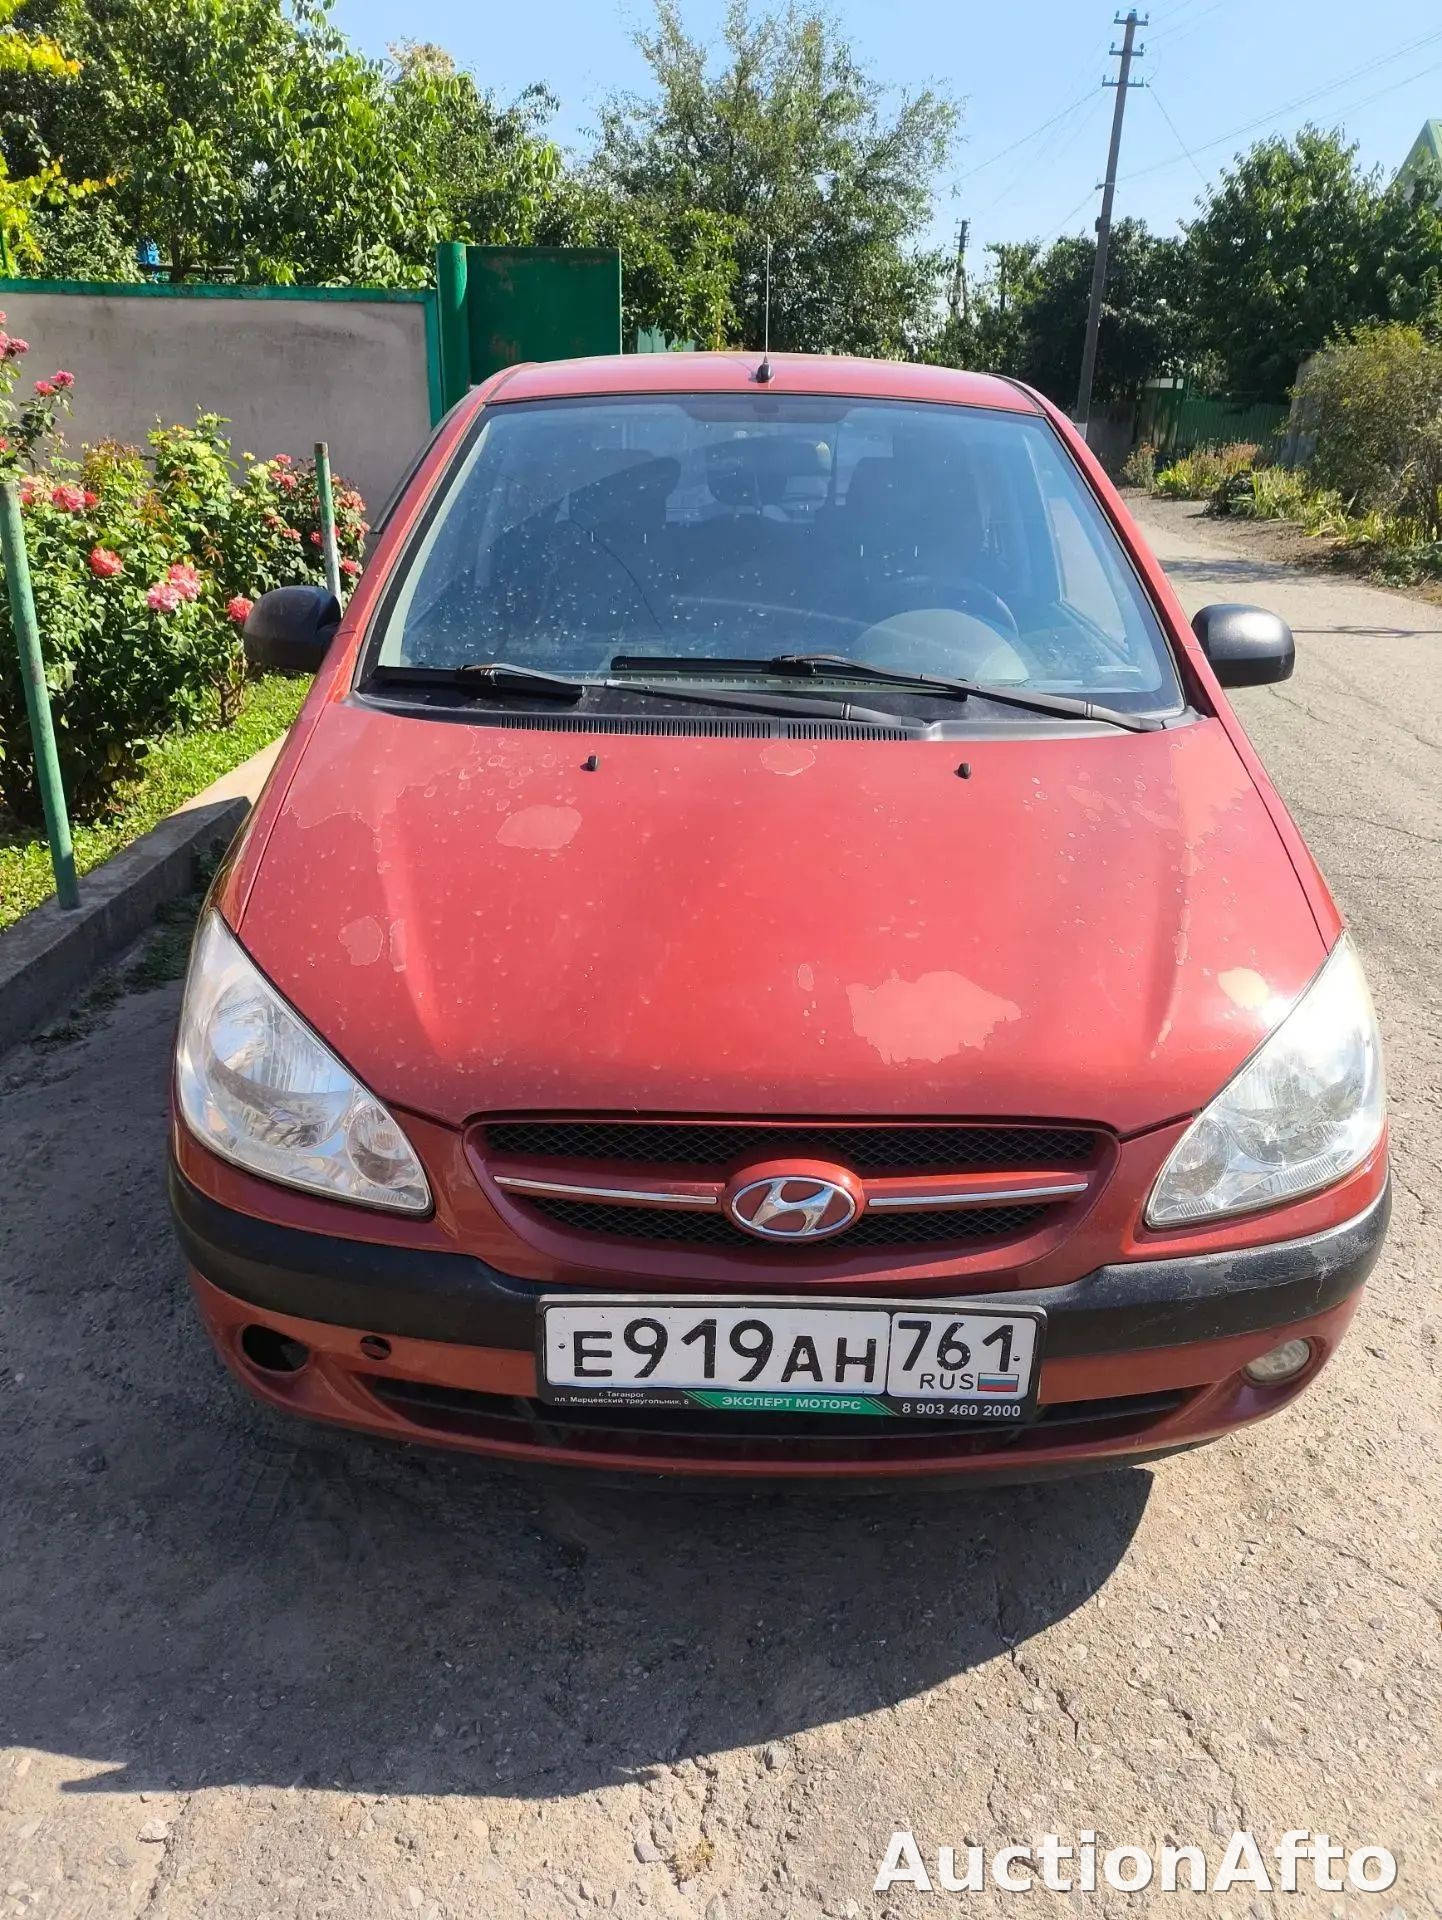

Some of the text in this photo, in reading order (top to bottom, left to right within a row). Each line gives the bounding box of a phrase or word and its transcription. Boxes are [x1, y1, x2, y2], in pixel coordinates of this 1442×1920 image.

[573, 1318, 876, 1383] Е919АН
[898, 1320, 1014, 1373] 761
[919, 1373, 974, 1390] RUS
[722, 1396, 861, 1410] ЭКСПЕРТ МОТОРС
[902, 1403, 1021, 1417] 8 903 460 2000
